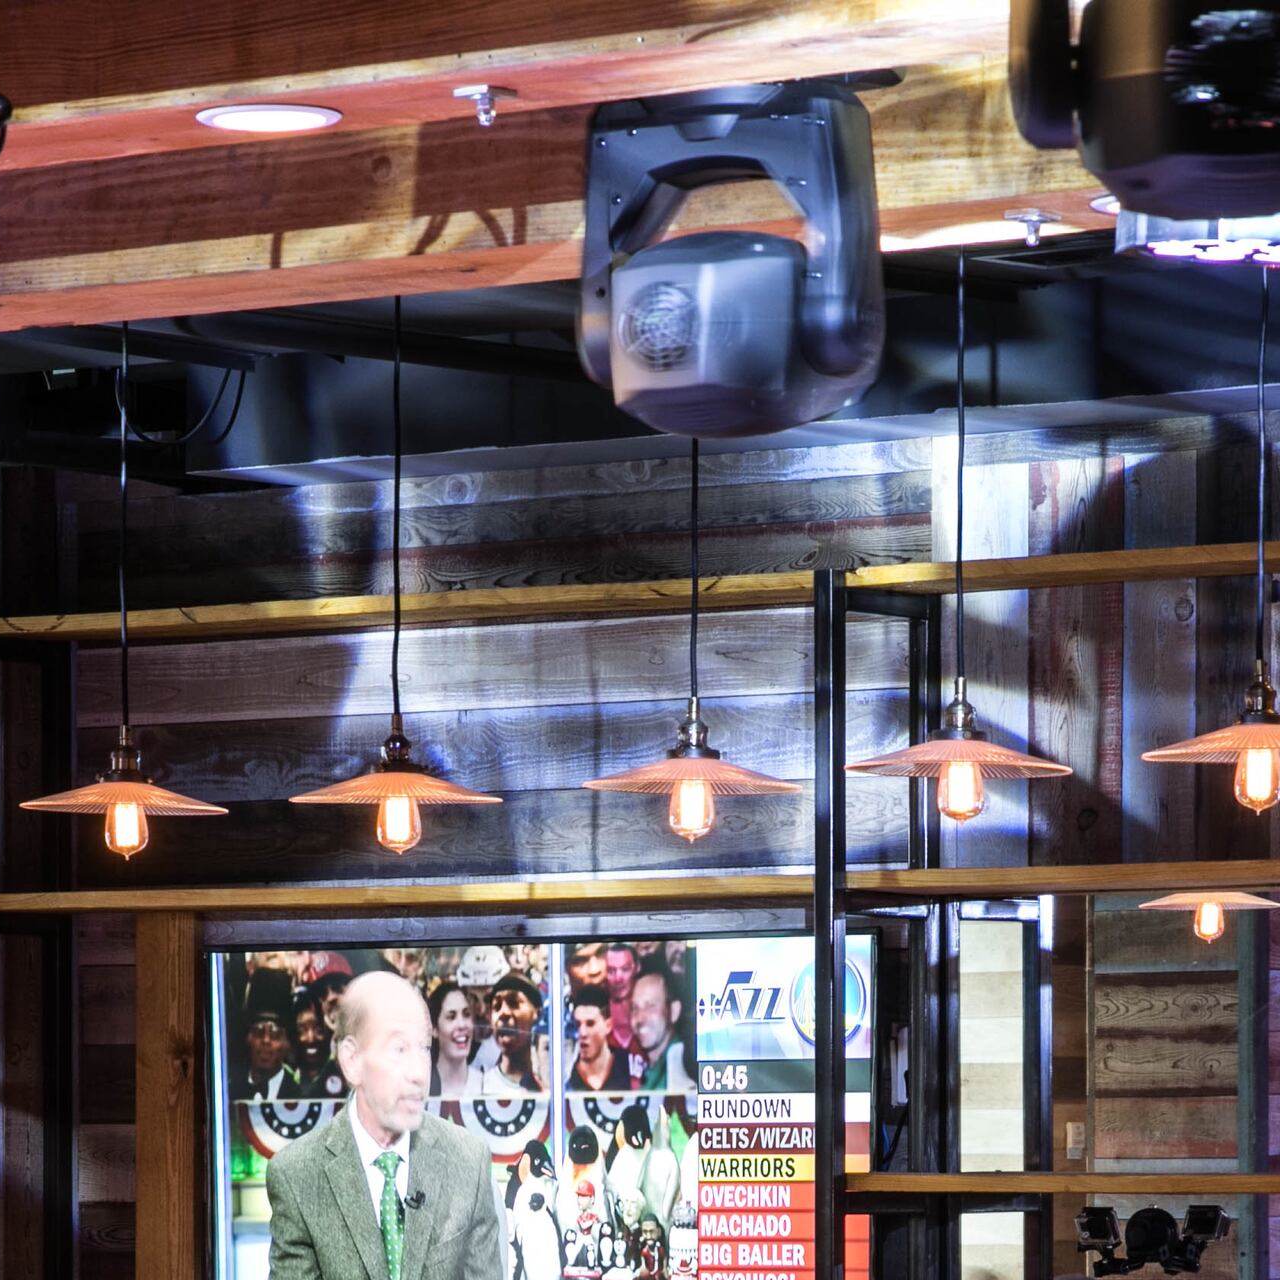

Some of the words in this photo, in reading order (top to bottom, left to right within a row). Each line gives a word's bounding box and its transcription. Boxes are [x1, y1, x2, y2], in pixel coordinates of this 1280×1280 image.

[701, 1065, 748, 1091] 0:45
[702, 1099, 792, 1119] RUNDOWN
[700, 1127, 815, 1149] CELTS/WIZAR
[701, 1157, 795, 1178] WARRIORS
[700, 1186, 790, 1208] OVECHKIN
[700, 1215, 791, 1236] MACHADO
[700, 1244, 732, 1266] BIG
[738, 1244, 805, 1266] BALLER
